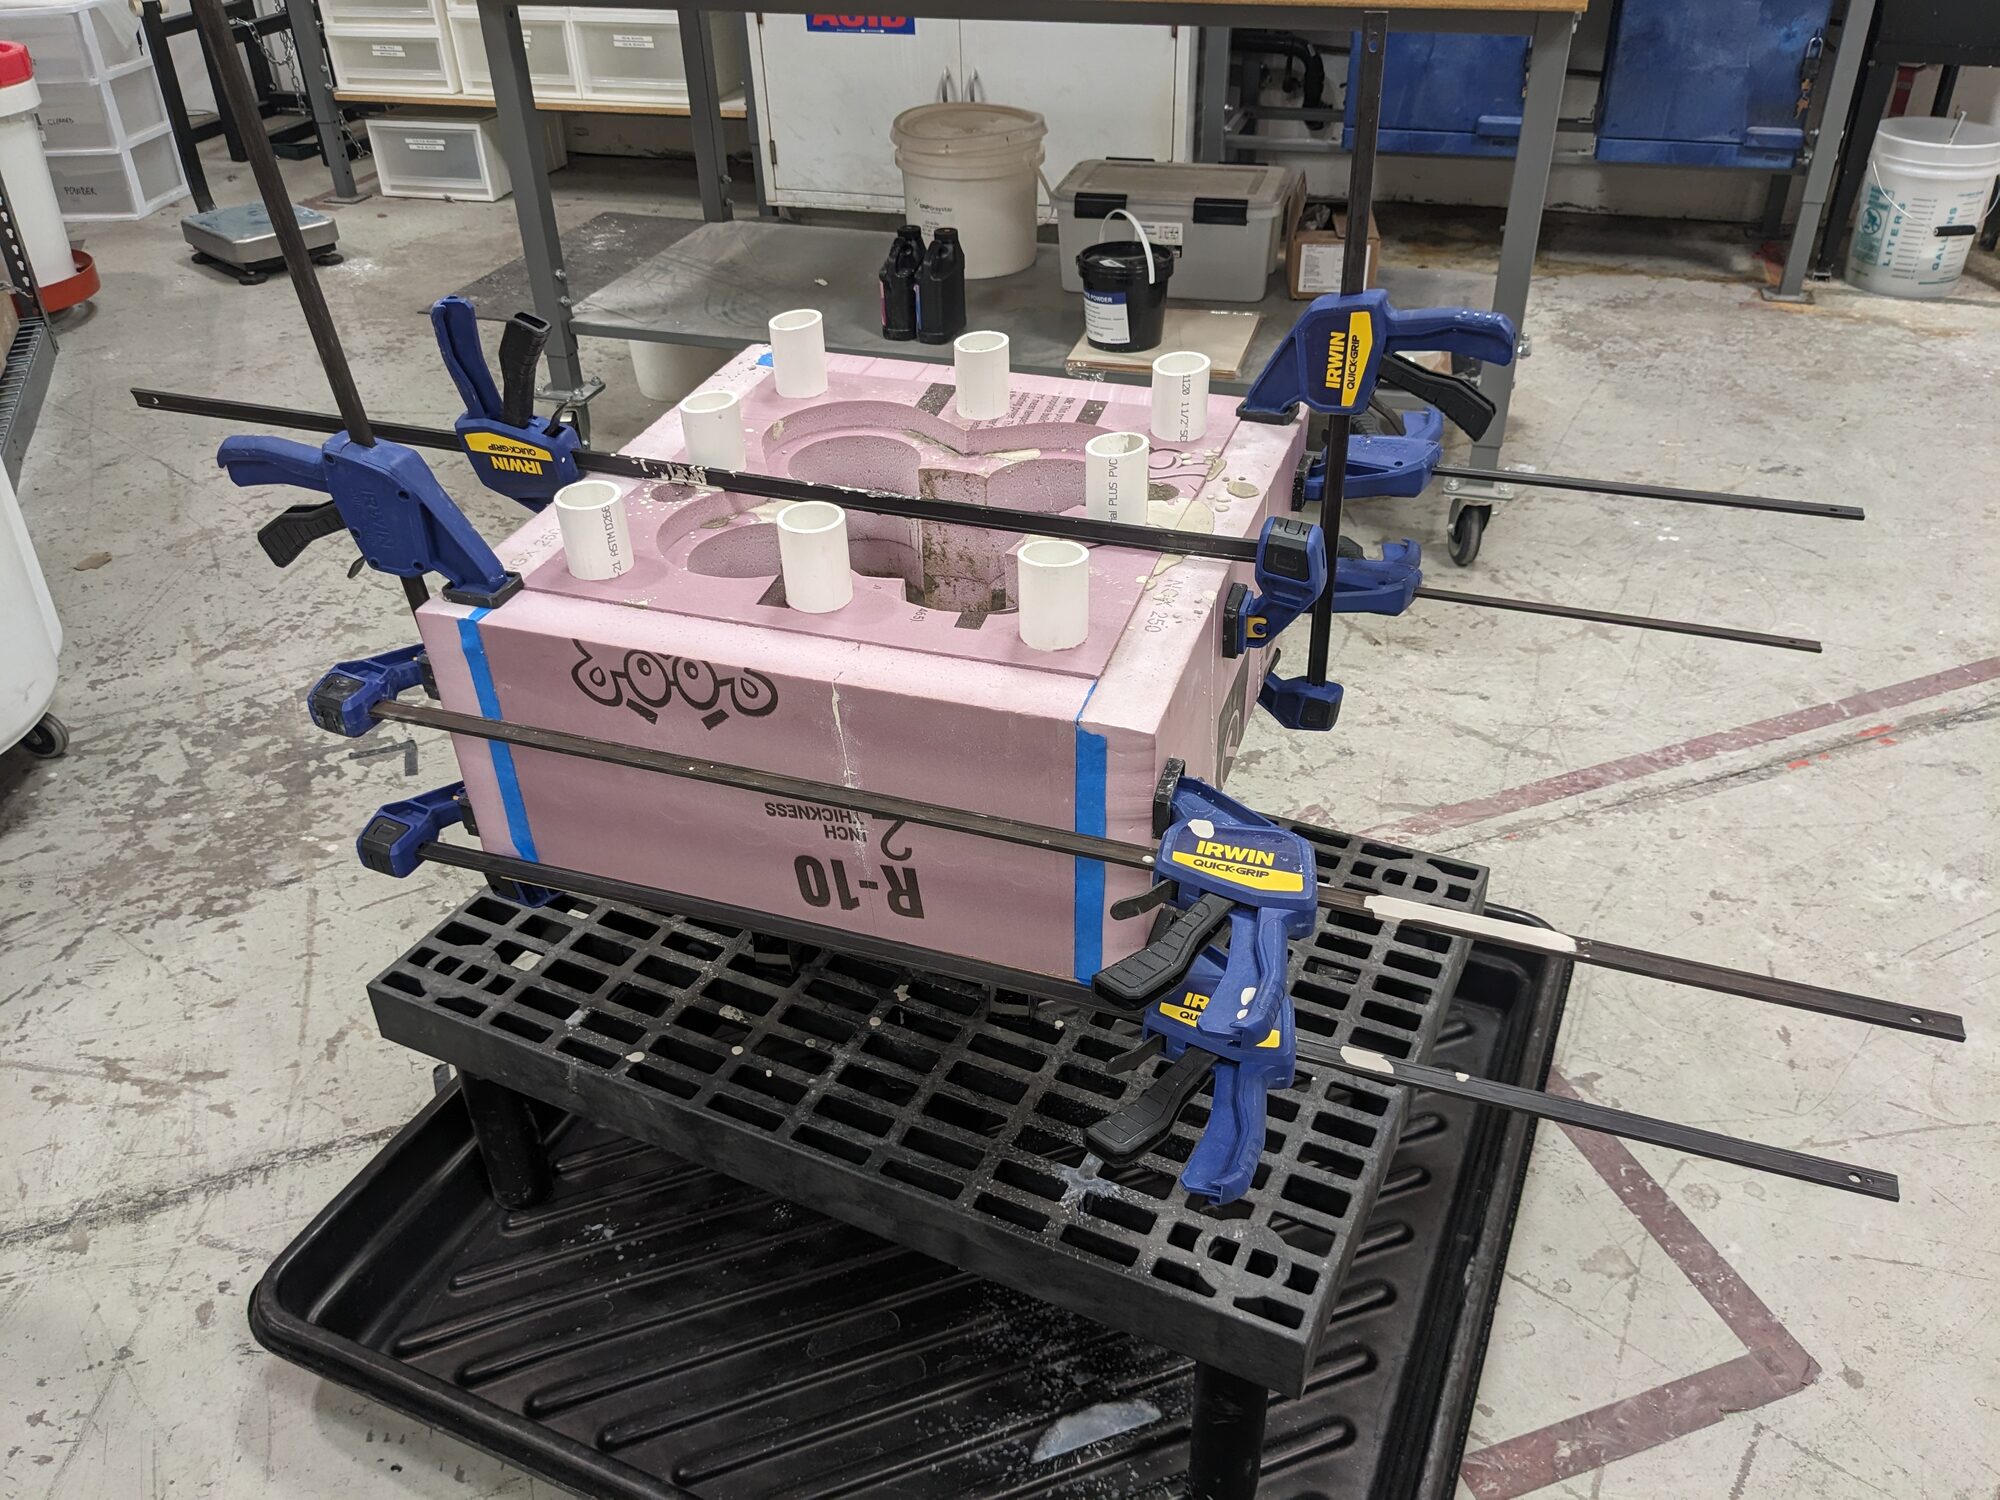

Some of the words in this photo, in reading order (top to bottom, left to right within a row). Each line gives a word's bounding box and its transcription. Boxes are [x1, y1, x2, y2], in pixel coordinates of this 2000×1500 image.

[1325, 331, 1346, 389] IRWIN
[1346, 334, 1360, 390] QUICK-GRIP
[487, 443, 537, 456] QUICK-GRIP
[490, 456, 543, 476] IRWIN
[1108, 458, 1118, 478] PVC
[1108, 482, 1118, 506] PLUS
[607, 531, 619, 557] ASTM
[1144, 611, 1169, 633] 250
[764, 802, 864, 824] THICKNESS
[823, 825, 867, 842] INCH
[871, 812, 913, 861] 2
[1196, 840, 1275, 867] IRWIN
[1193, 859, 1270, 878] QUICK-GRIP
[794, 855, 924, 919] R-10
